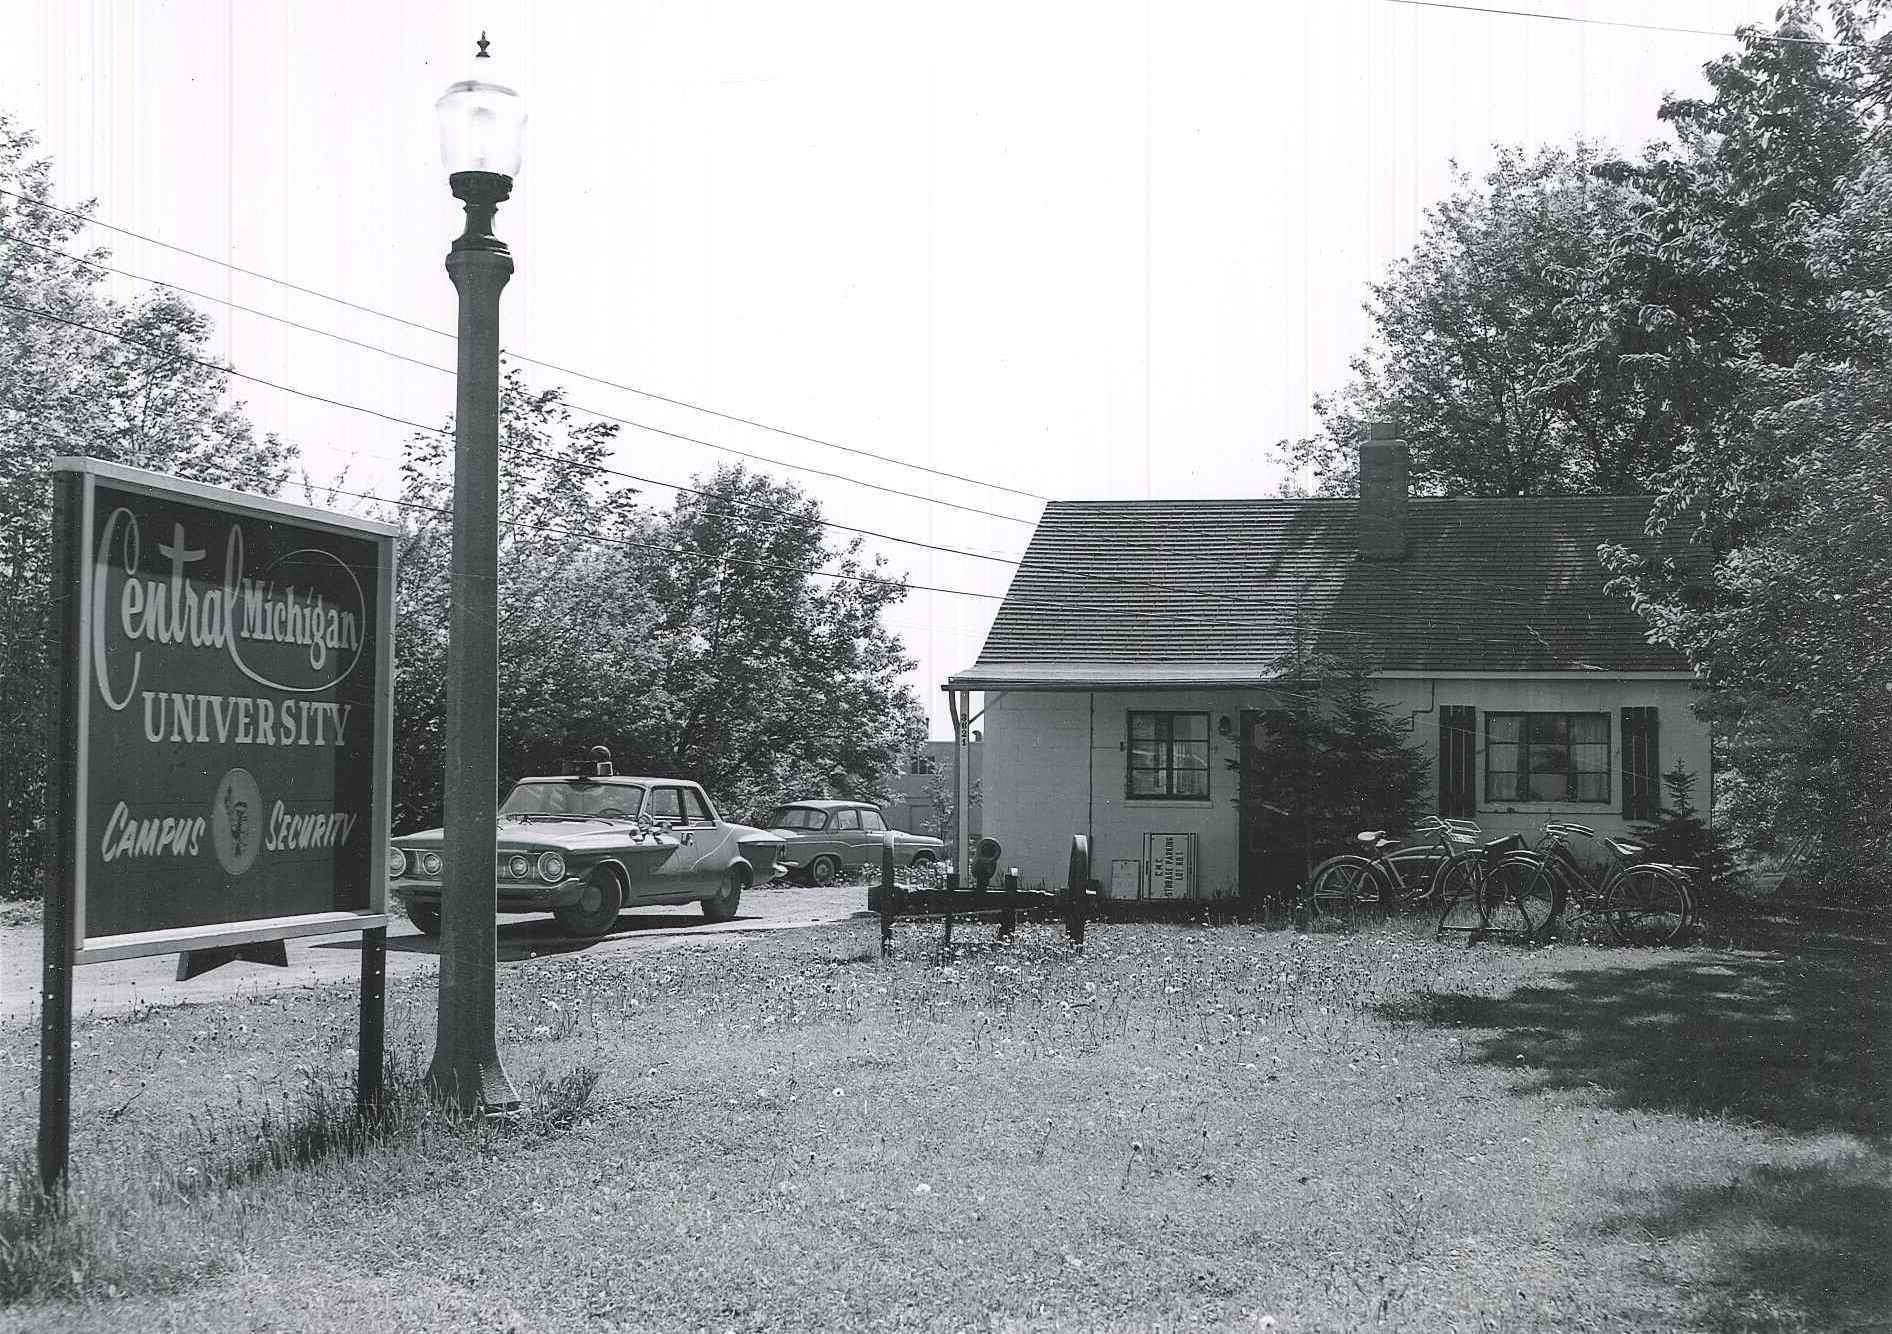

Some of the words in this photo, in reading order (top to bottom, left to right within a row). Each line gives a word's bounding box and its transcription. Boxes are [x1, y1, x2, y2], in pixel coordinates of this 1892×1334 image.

[94, 507, 243, 710] Central
[241, 577, 359, 670] Michigan
[142, 691, 351, 747] UNIVERSITY
[102, 801, 206, 863] CAMPUS
[265, 800, 357, 852] SECURITY
